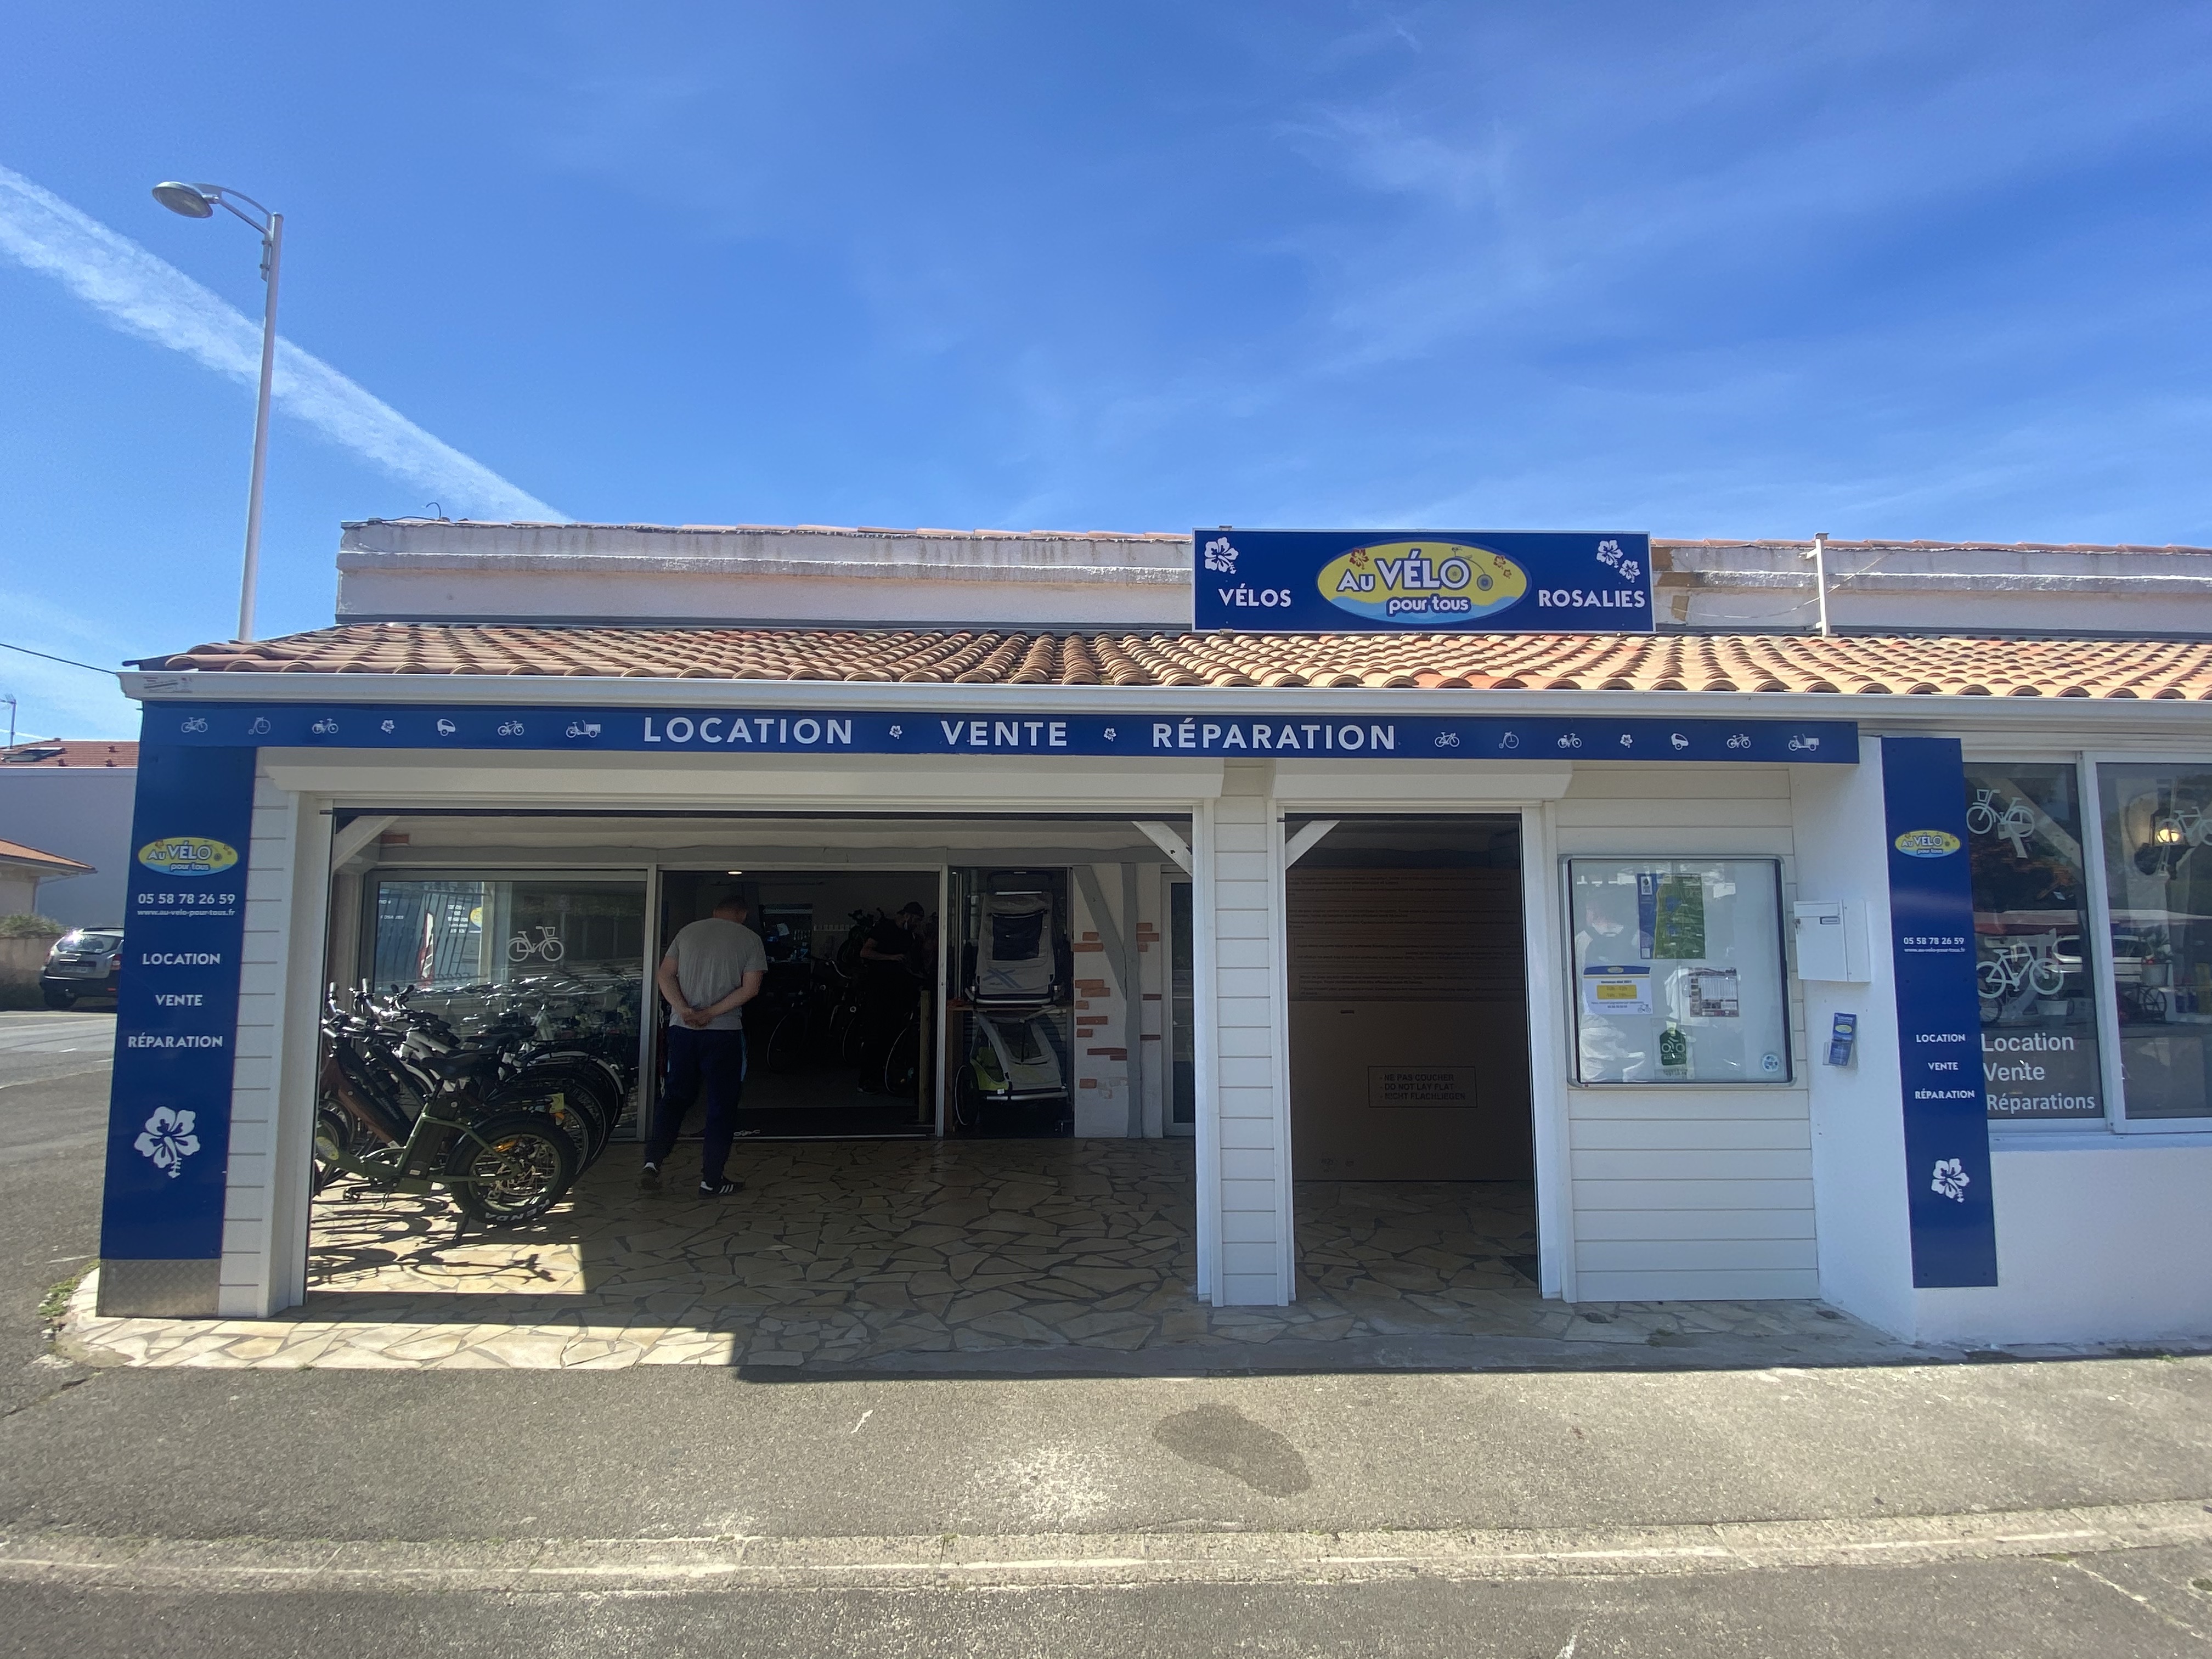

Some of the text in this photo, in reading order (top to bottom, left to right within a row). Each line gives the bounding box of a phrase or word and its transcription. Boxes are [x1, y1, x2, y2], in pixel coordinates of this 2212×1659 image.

[1337, 550, 1470, 591] Au VÉLO
[1218, 583, 1291, 607] VÉLOS
[1389, 595, 1469, 614] pour tous
[1539, 589, 1644, 608] ROSALIES
[644, 716, 1395, 750] LOCATION VENTE RÉPARATION
[1913, 833, 1943, 846] VÉLO
[148, 841, 212, 860] Au VÉLO
[138, 894, 235, 904] 05 58 78 26 59
[137, 909, 236, 917] www.au-velo-pour-tous.fr
[142, 953, 221, 964] LOCATION
[155, 994, 203, 1006] VENTE
[128, 1032, 223, 1048] RÉPARATION
[1916, 1034, 1966, 1043] LOCATION
[1980, 1032, 2074, 1052] Location
[1928, 1062, 1959, 1071] VENTE
[1983, 1062, 2045, 1082] Vente
[1915, 1088, 1976, 1099] RÉPARATION
[1987, 1092, 2095, 1114] Réparations
[484, 1198, 550, 1222] KENDA
